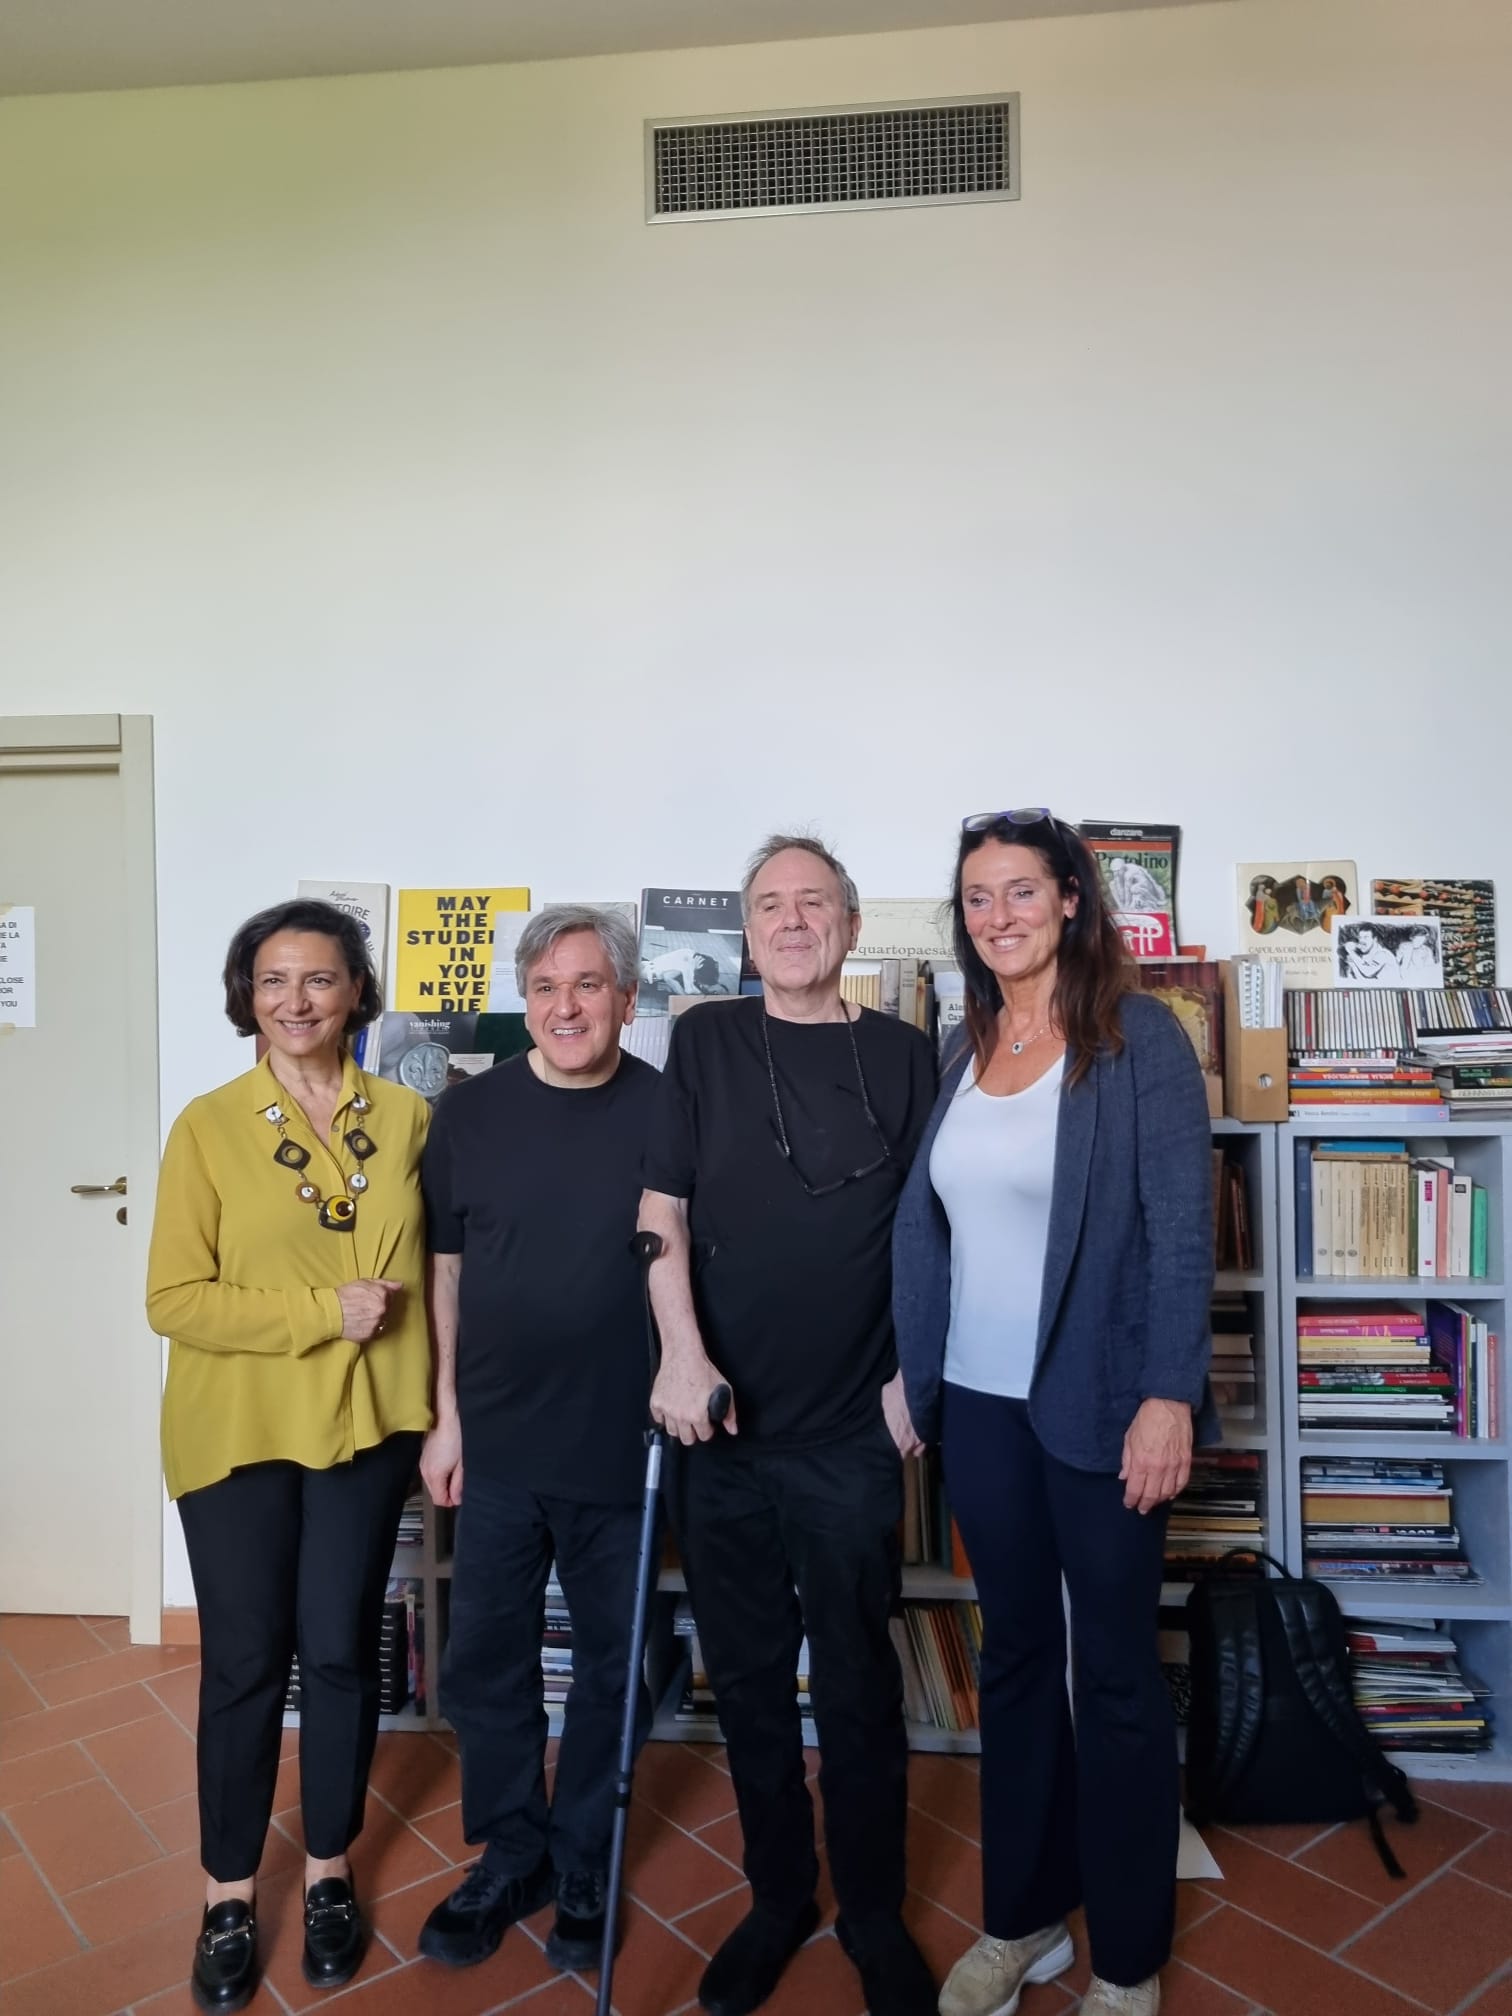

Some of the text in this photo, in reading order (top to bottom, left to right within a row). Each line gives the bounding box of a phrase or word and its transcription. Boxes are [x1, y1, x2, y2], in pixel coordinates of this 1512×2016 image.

[437, 896, 492, 911] MAY
[662, 895, 729, 907] CARNET
[330, 903, 371, 921] TOIRE
[440, 913, 488, 928] THE
[449, 947, 475, 961] IN
[438, 964, 485, 978] YOU
[420, 981, 491, 996] NEVE
[0, 1000, 18, 1008] YOU
[441, 998, 481, 1012] DIE
[408, 1019, 451, 1030] vanishing
